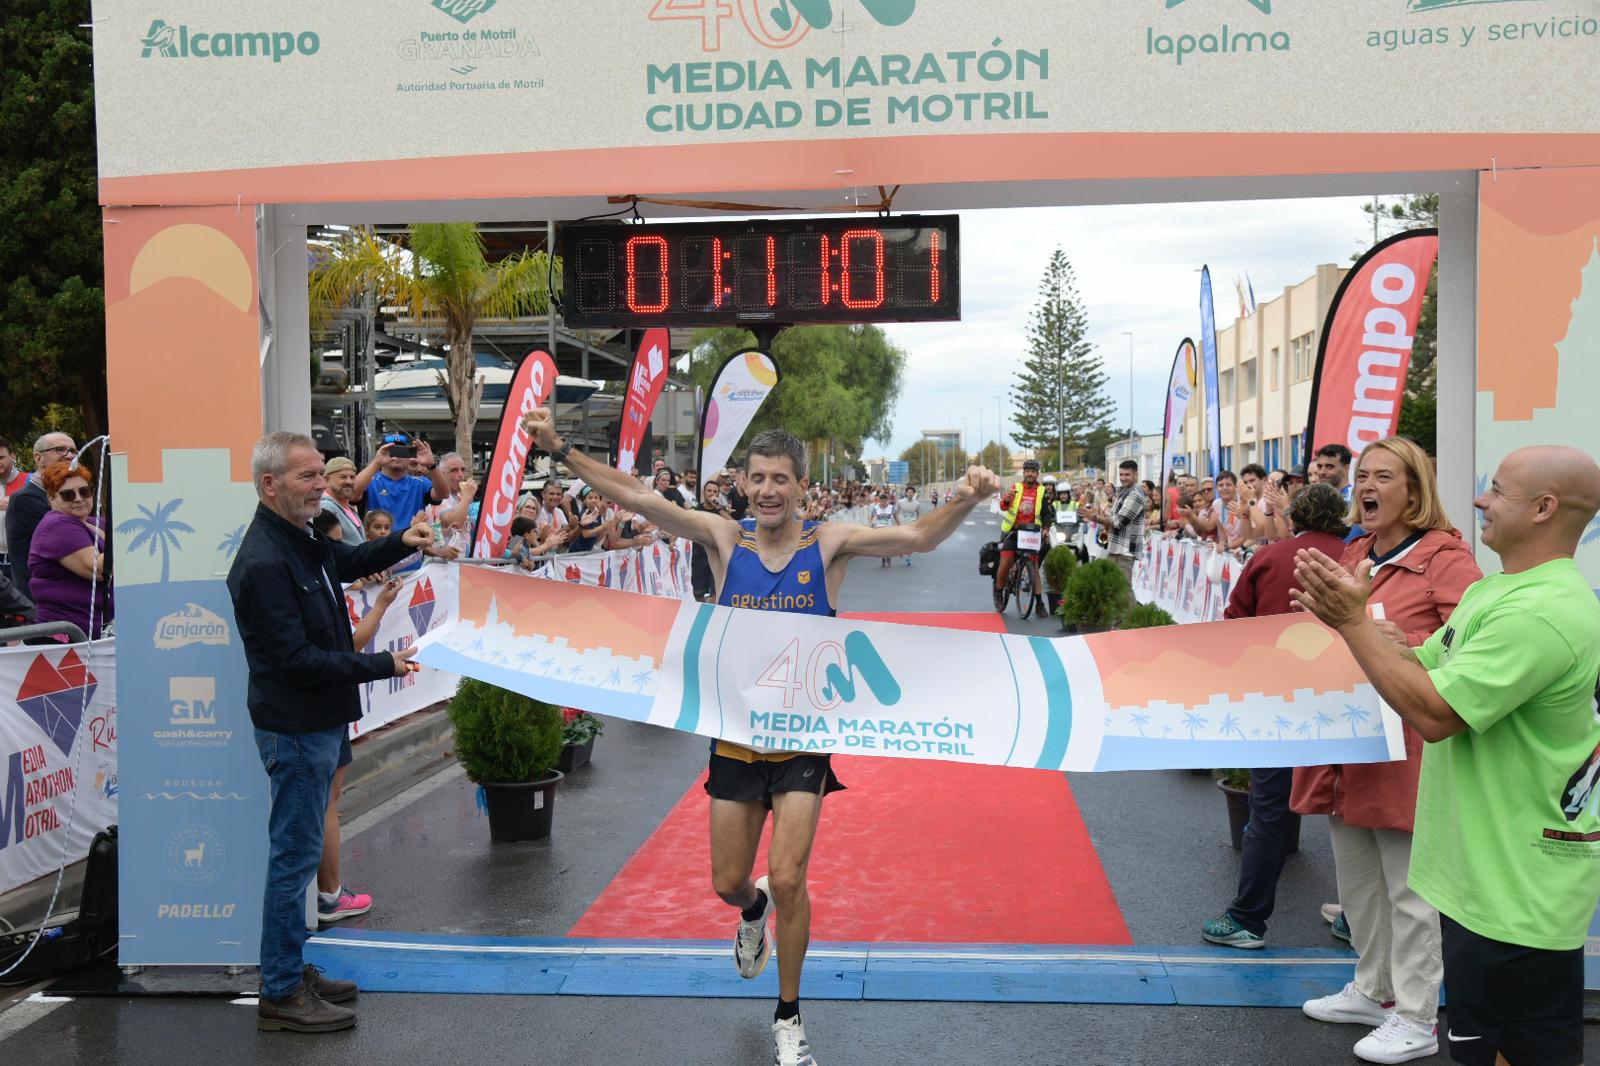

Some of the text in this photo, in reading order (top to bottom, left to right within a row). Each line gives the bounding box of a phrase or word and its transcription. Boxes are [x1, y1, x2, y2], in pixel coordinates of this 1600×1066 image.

[141, 19, 320, 62] Alcampo
[420, 28, 517, 42] Puerto de Motril
[1147, 25, 1290, 65] lapalma
[1366, 25, 1449, 51] aguas
[1461, 24, 1476, 47] y
[397, 36, 541, 61] GRANADA
[646, 36, 1049, 95] MEDIA MARATÓN
[396, 79, 544, 92] Autoridad Portuaria de Motril
[645, 91, 1049, 132] CIUDAD DE MOTRIL
[625, 229, 939, 314] 01:11:01
[731, 591, 815, 609] agustinos
[160, 620, 225, 640] Lanjarón
[153, 728, 233, 740] cash&carry
[750, 710, 974, 739] MEDIA MARATÓN
[845, 735, 876, 749] DE
[884, 738, 975, 757] MOTRIL
[158, 904, 235, 918] PADELLO
